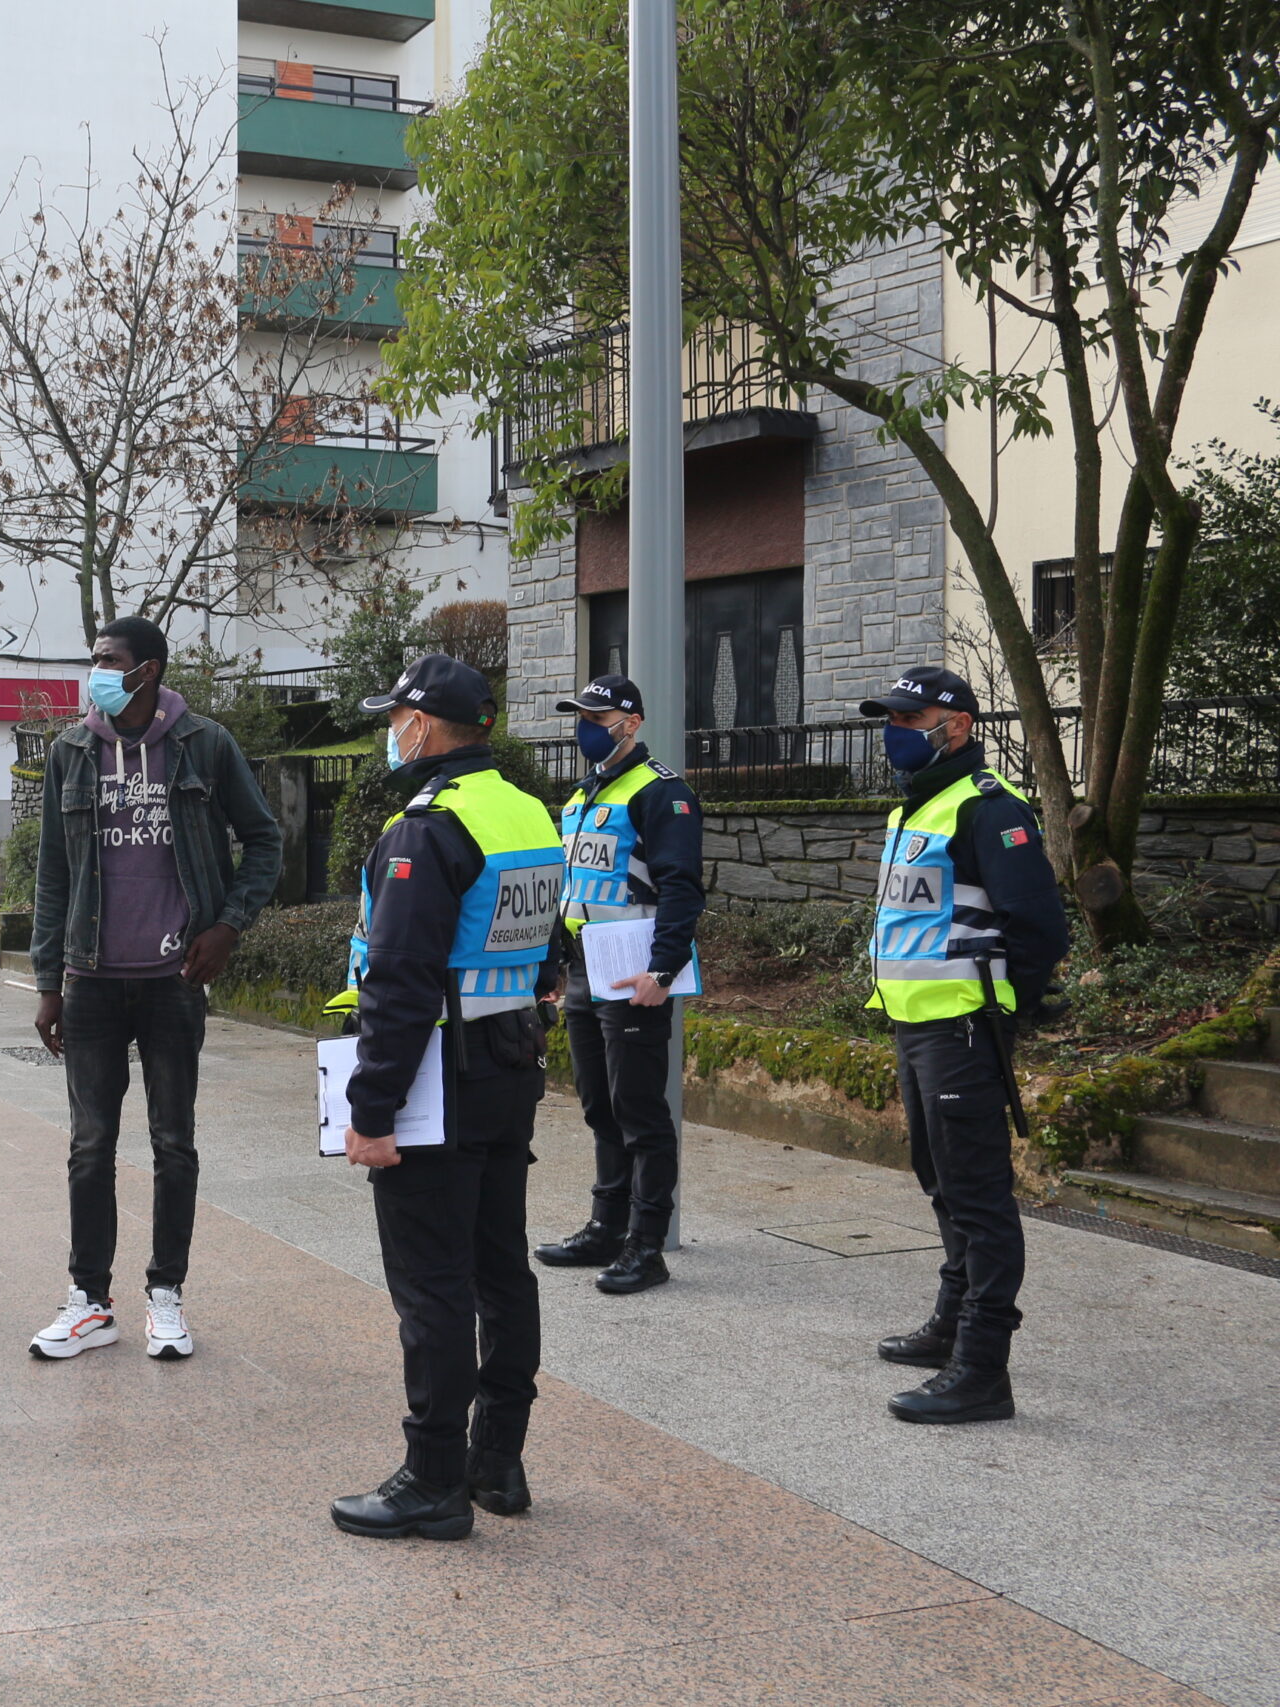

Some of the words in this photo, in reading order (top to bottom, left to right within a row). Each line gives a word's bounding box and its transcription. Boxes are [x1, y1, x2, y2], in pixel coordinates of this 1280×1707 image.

[581, 683, 612, 699] LÍCIA
[125, 772, 167, 801] Laun
[103, 825, 174, 847] TO-K-YO
[496, 872, 560, 920] POLÍCIA
[160, 931, 181, 957] 65
[490, 925, 537, 944] SEGURANÇA
